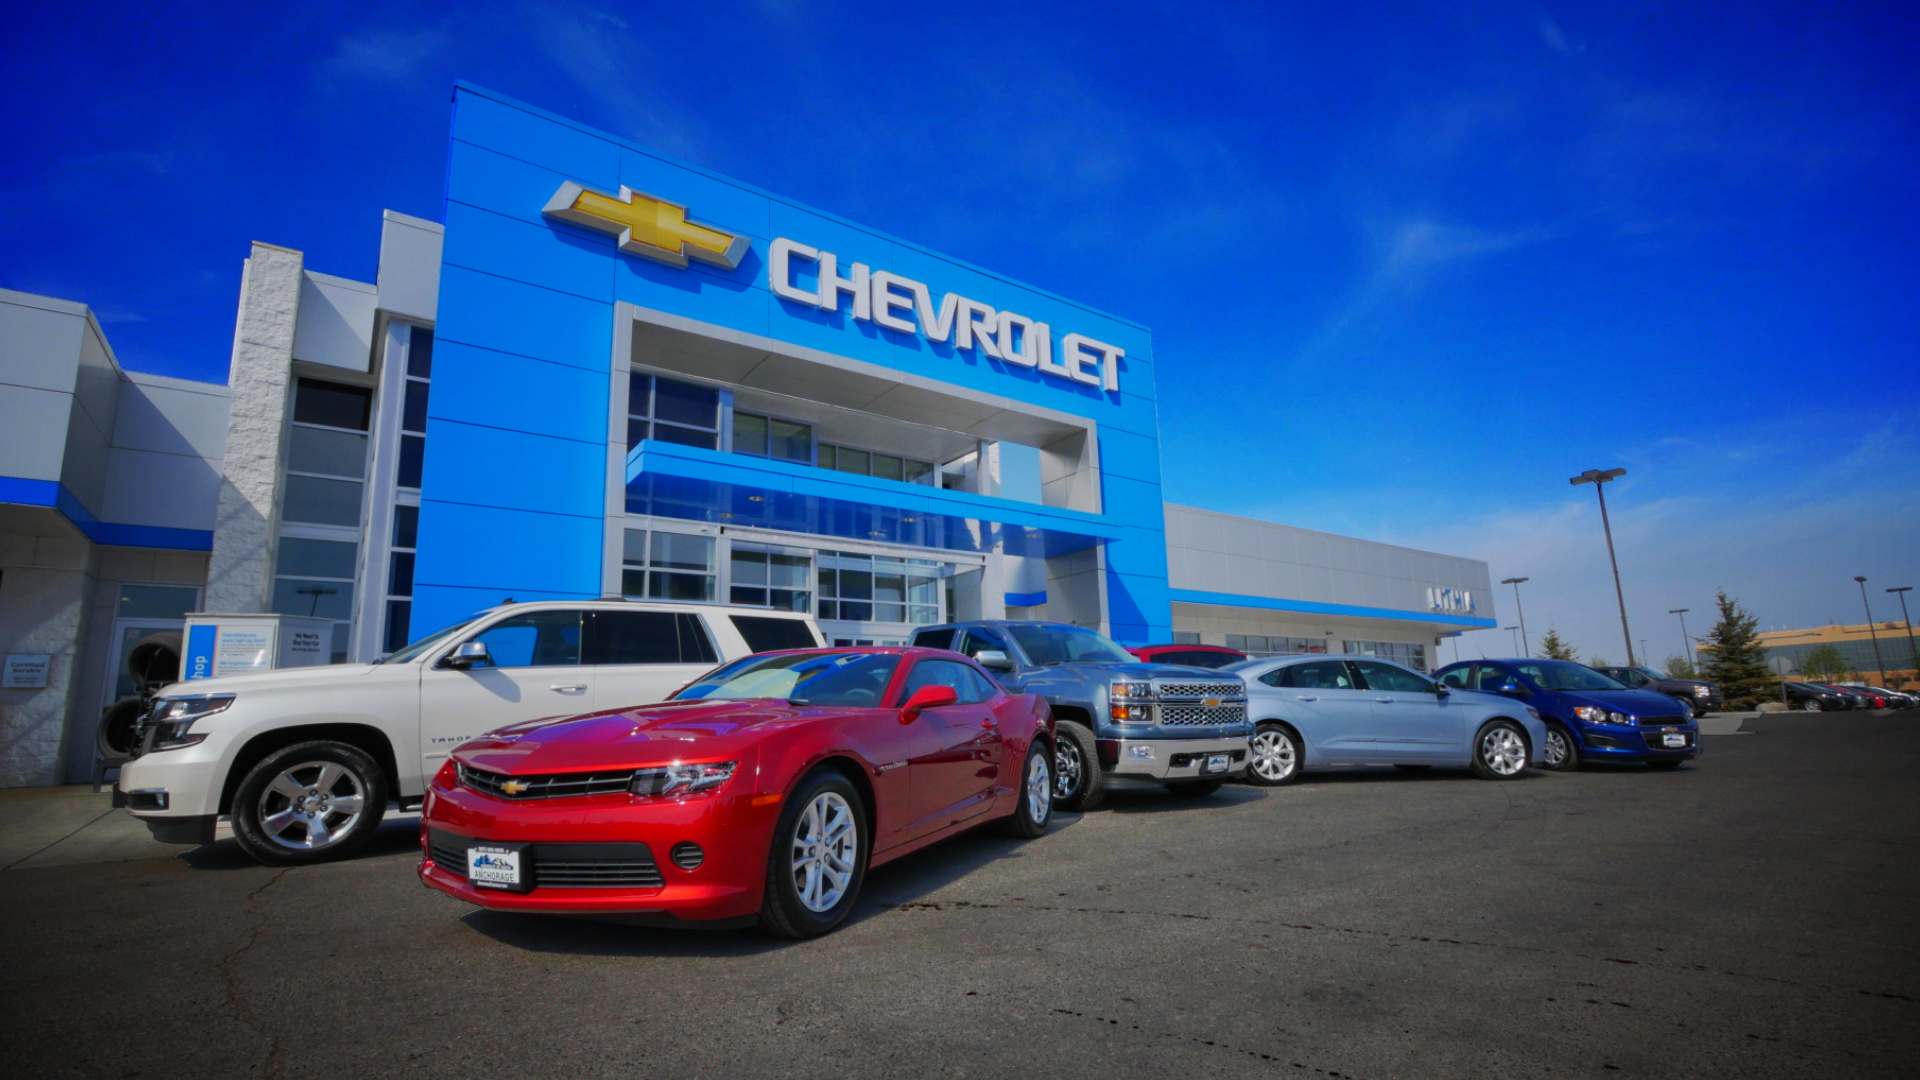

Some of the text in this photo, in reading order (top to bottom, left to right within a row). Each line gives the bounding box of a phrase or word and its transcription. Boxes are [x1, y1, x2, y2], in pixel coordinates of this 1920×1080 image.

[769, 237, 1125, 392] CHEVROLET
[1427, 587, 1477, 612] LITHIA
[189, 656, 209, 678] hop
[475, 869, 515, 882] ANCHORAGE
